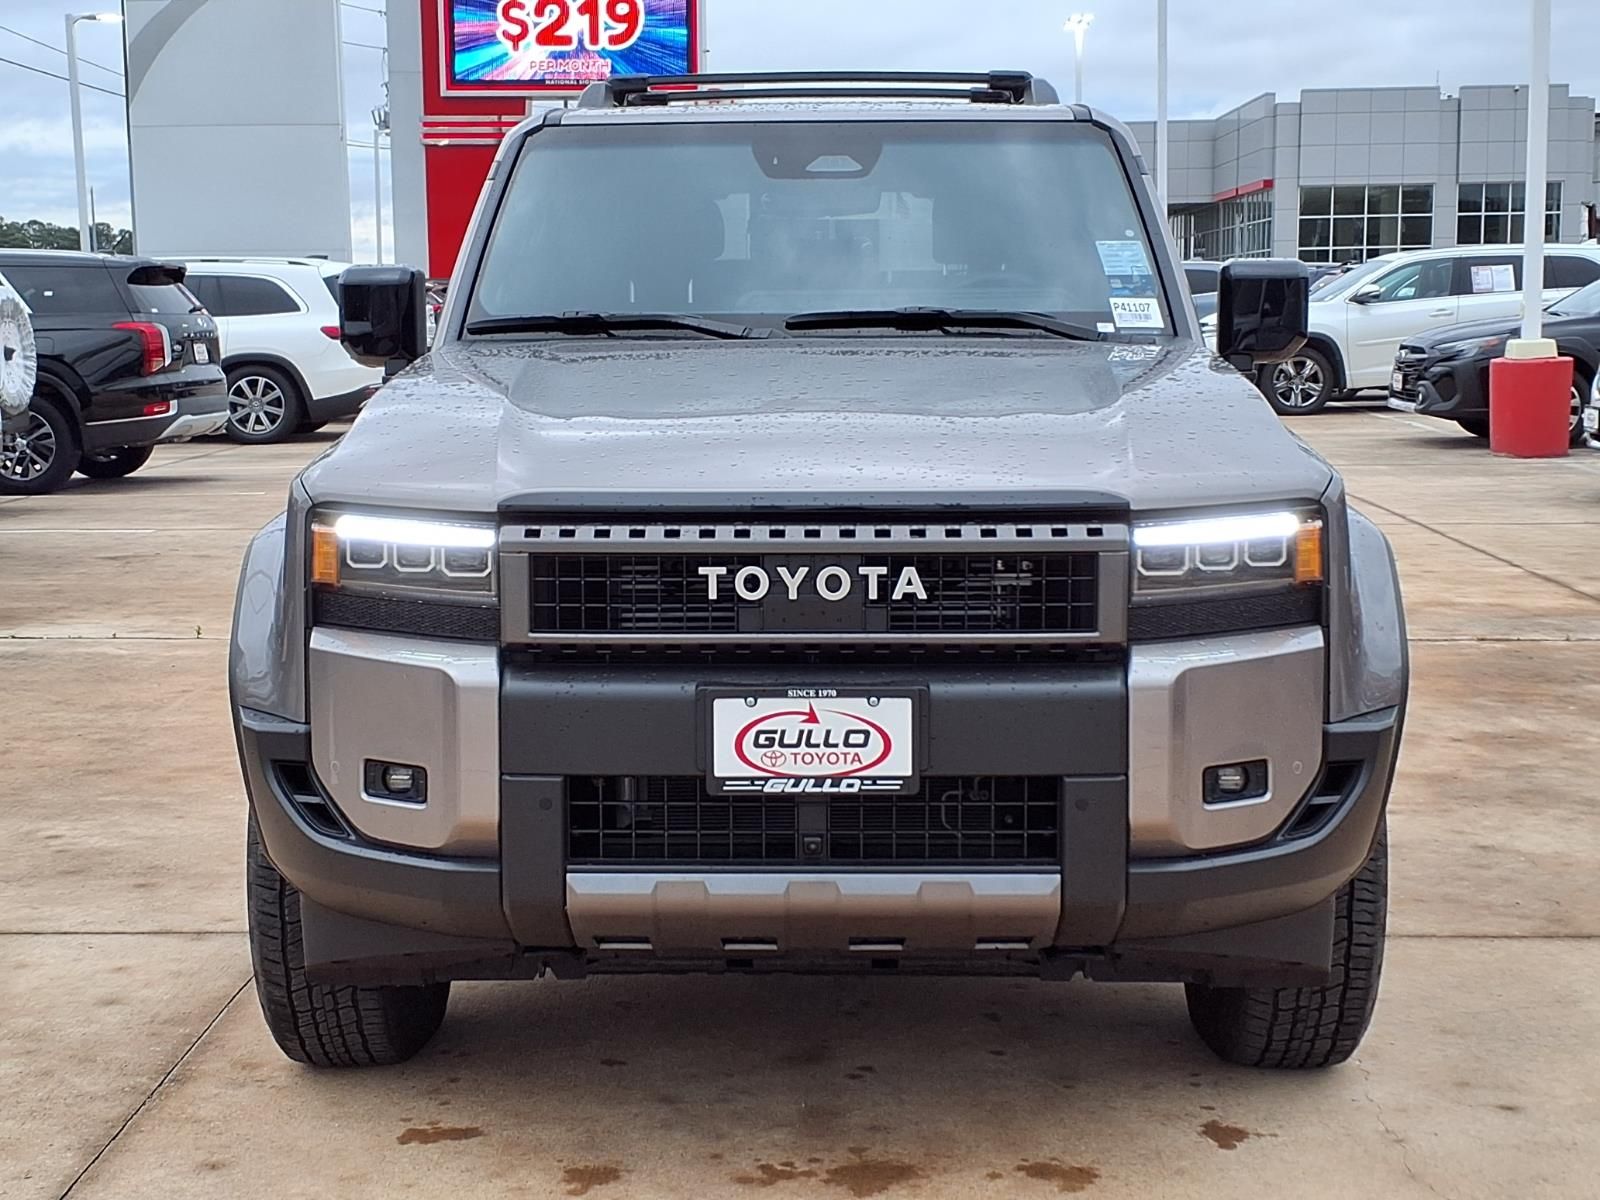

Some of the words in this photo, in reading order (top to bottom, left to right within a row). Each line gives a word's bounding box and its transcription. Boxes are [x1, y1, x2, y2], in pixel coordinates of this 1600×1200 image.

[501, 0, 641, 51] $219
[529, 60, 555, 71] PER
[559, 60, 609, 71] MONTH
[1113, 302, 1150, 312] P41107
[698, 566, 927, 600] TOYOTA
[787, 689, 816, 697] SINCE
[818, 689, 837, 697] 1970
[753, 729, 871, 749] GULLO
[790, 752, 863, 766] TOYOTA
[763, 779, 861, 793] GULLO
